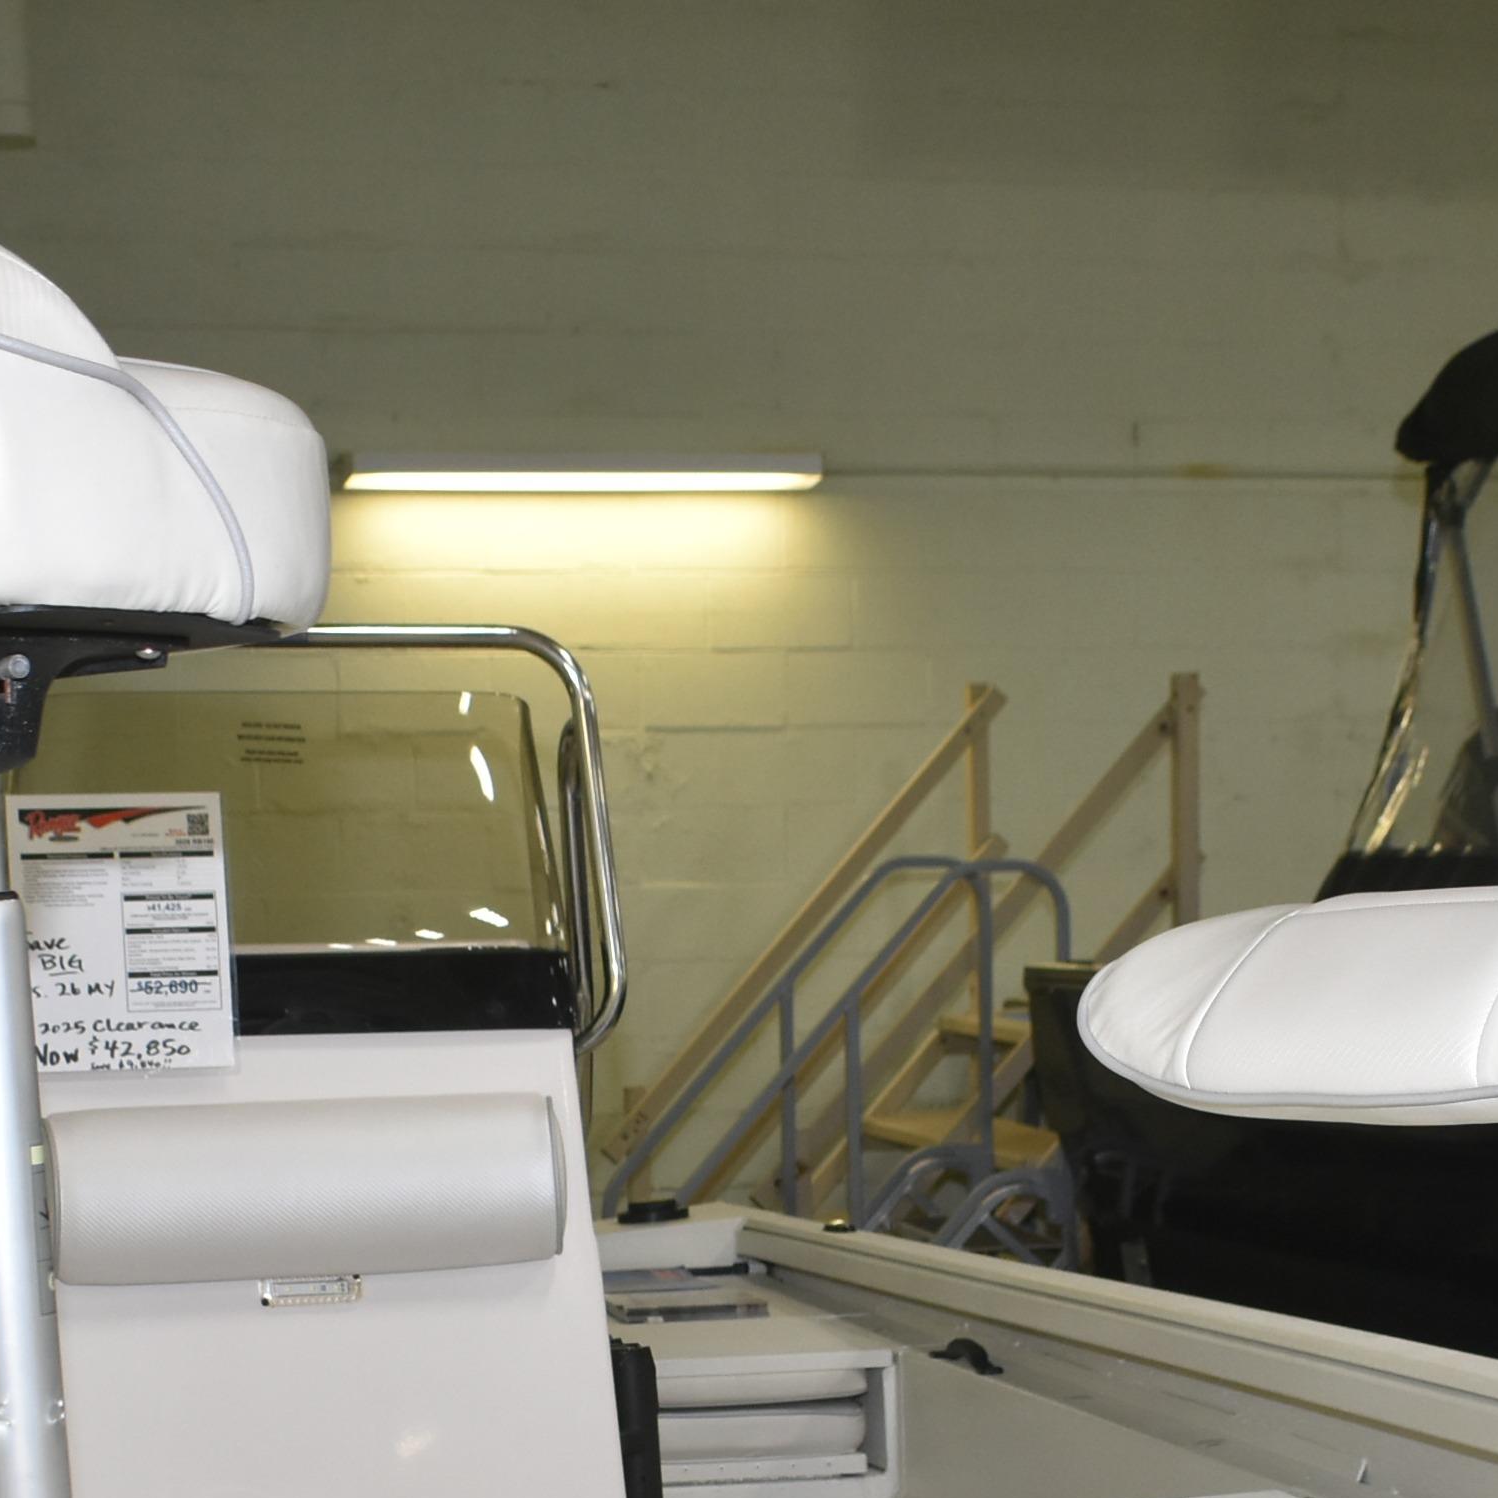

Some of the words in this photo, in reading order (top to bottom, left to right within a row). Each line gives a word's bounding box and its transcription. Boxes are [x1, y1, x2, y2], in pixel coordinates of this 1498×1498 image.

[27, 932, 71, 951] ave
[37, 953, 85, 973] BIG
[38, 1020, 86, 1034] 2025
[92, 1018, 202, 1033] Clearance
[88, 1036, 192, 1061] $42,850
